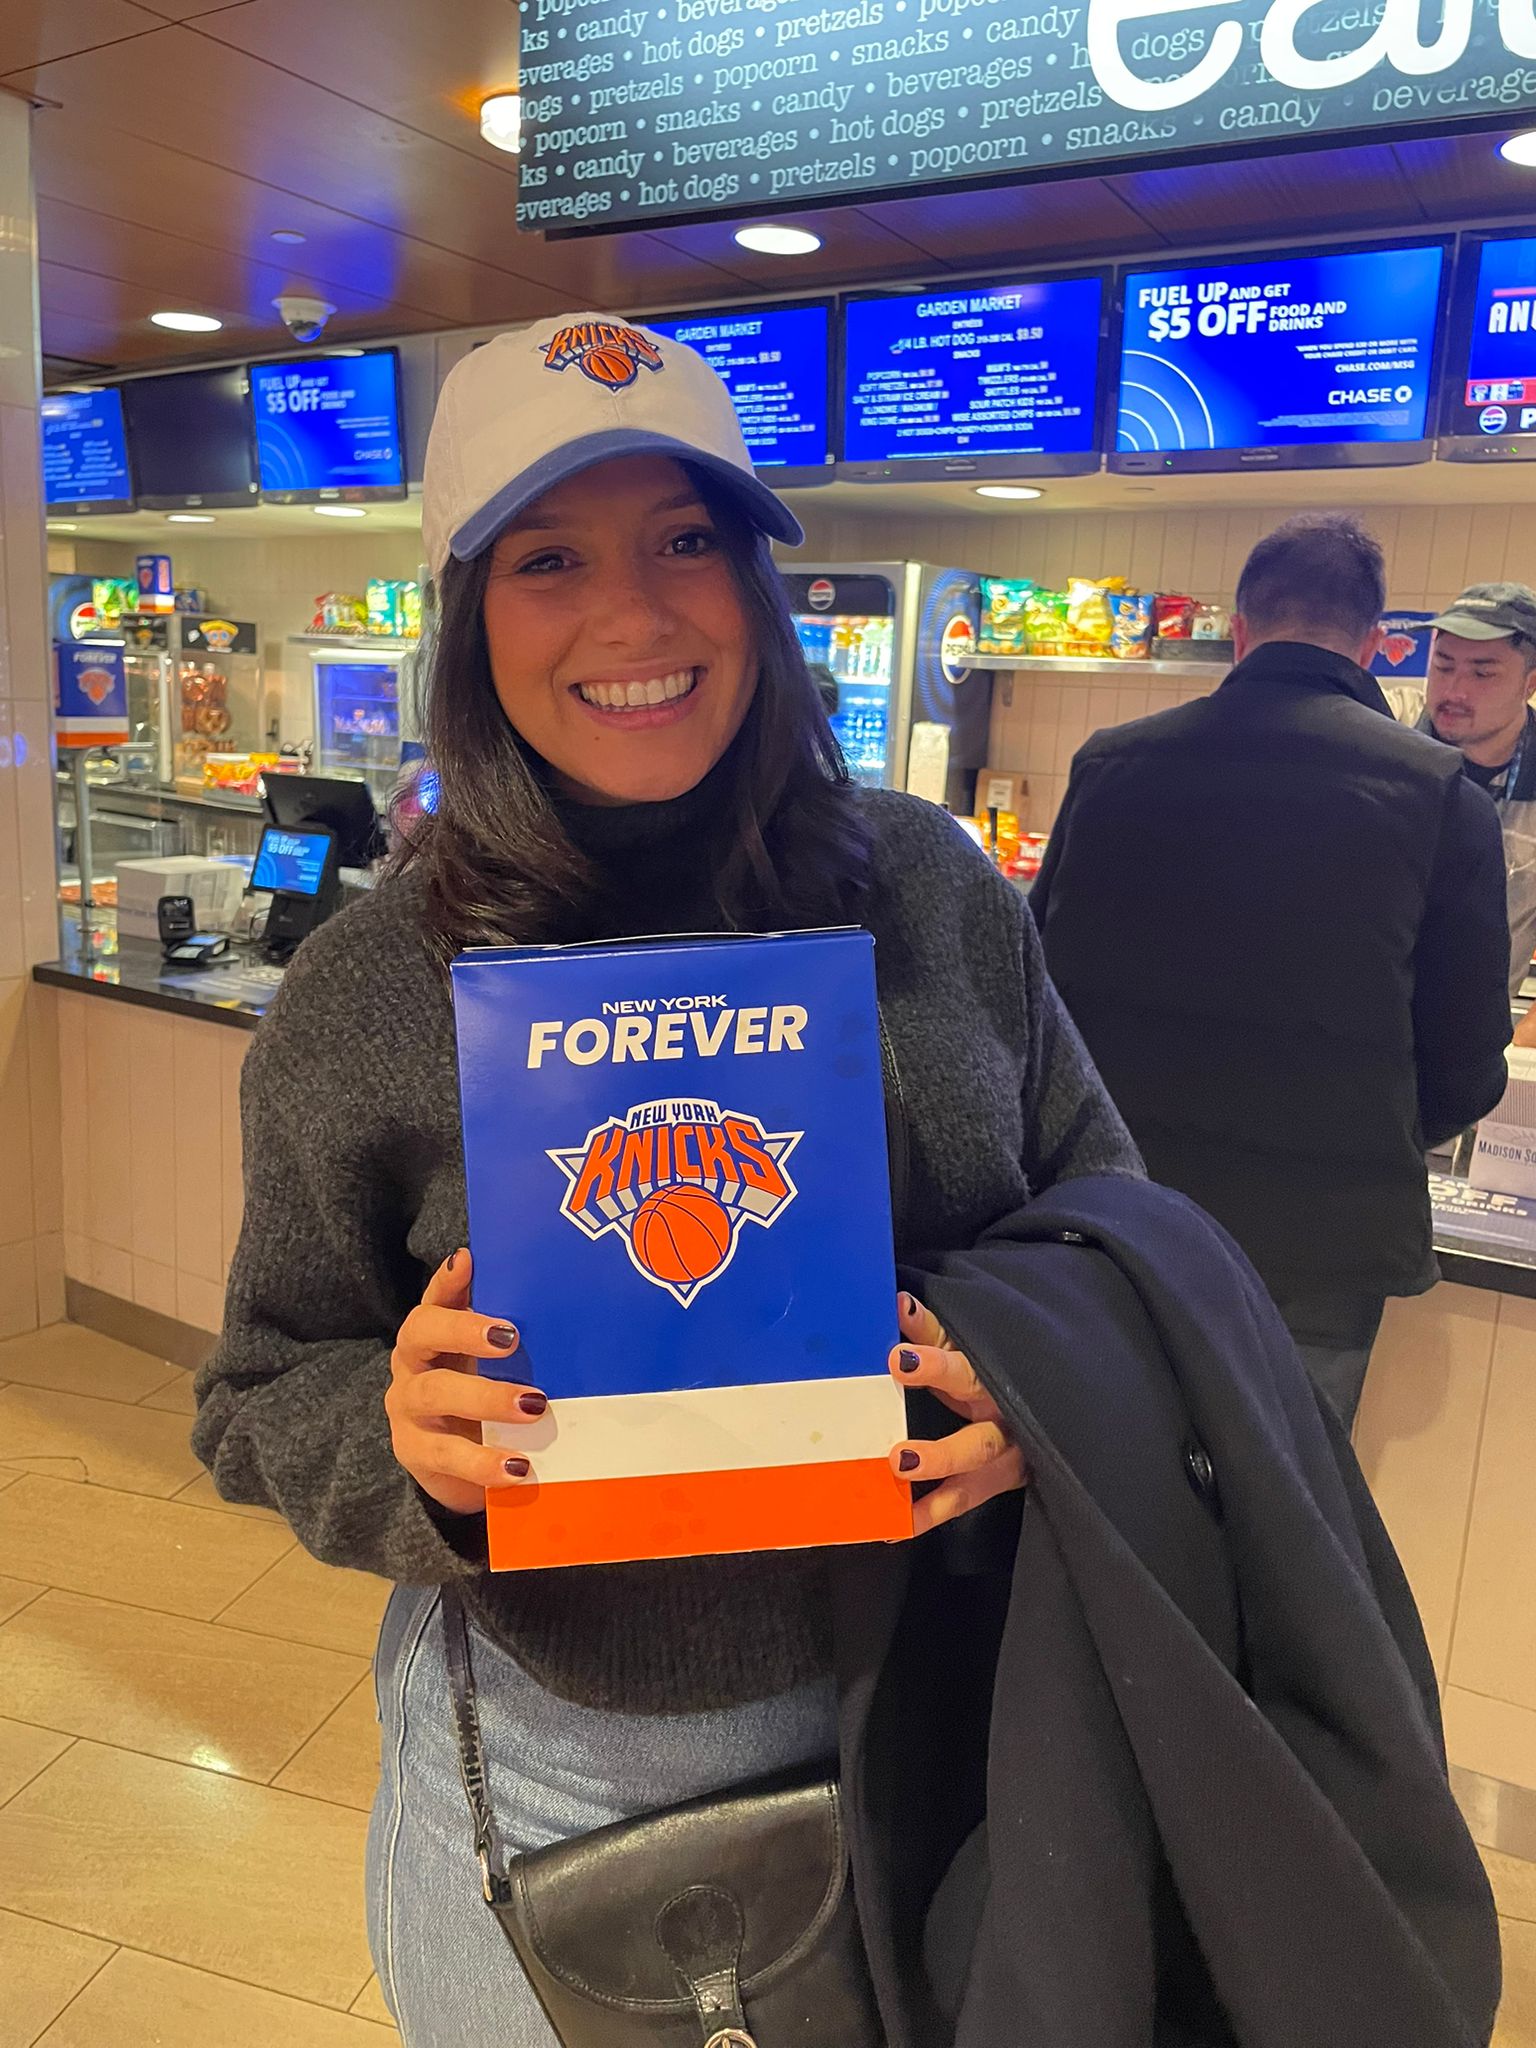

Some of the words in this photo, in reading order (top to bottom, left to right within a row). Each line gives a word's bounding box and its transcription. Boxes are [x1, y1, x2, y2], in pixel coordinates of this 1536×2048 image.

[576, 9, 649, 42] candy
[642, 37, 682, 64] hot
[688, 28, 744, 57] dogs
[775, 2, 884, 47] pretzels
[588, 73, 684, 114] pretzels
[713, 53, 819, 94] popcorn
[851, 29, 949, 66] snacks
[986, 6, 1081, 43] candy
[1087, 0, 1536, 111] ea
[534, 120, 628, 157] popcorn
[655, 101, 741, 133] snacks
[772, 82, 855, 116] candy
[886, 56, 1032, 98] beverages
[1131, 29, 1206, 61] dogs
[573, 150, 645, 179] candy
[672, 131, 798, 166] beverages
[829, 114, 875, 144] hot
[882, 107, 945, 138] dogs
[980, 82, 1102, 129] pretzels
[638, 178, 678, 206] hot
[683, 173, 740, 202] dogs
[769, 152, 876, 195] pretzels
[909, 135, 1028, 177] popcorn
[1066, 113, 1177, 150] snacks
[1219, 93, 1324, 128] candy
[916, 300, 968, 317] GARDEN
[970, 294, 1023, 312] MARKET
[1138, 285, 1193, 309] FUEL
[1197, 281, 1229, 303] UP
[1228, 286, 1261, 301] AND
[1263, 283, 1291, 297] GET
[1147, 307, 1191, 342] $5
[1197, 300, 1268, 337] OFF
[1269, 304, 1311, 319] FOOD
[1312, 300, 1347, 316] AND
[1268, 316, 1324, 332] DRINKS
[1488, 300, 1536, 334] AN
[545, 323, 662, 366] KNICKS
[930, 334, 951, 347] HOT
[952, 332, 975, 346] DOG
[266, 391, 287, 414] $5
[288, 388, 320, 412] OFF
[1328, 387, 1392, 405] CHASE
[602, 999, 657, 1015] NEW
[660, 994, 728, 1011] YORK
[527, 1005, 809, 1069] FOREVER
[629, 1104, 668, 1129] NEW
[672, 1102, 718, 1124] YORK
[569, 1119, 788, 1214] KNICKS
[1477, 1140, 1521, 1160] MADISON
